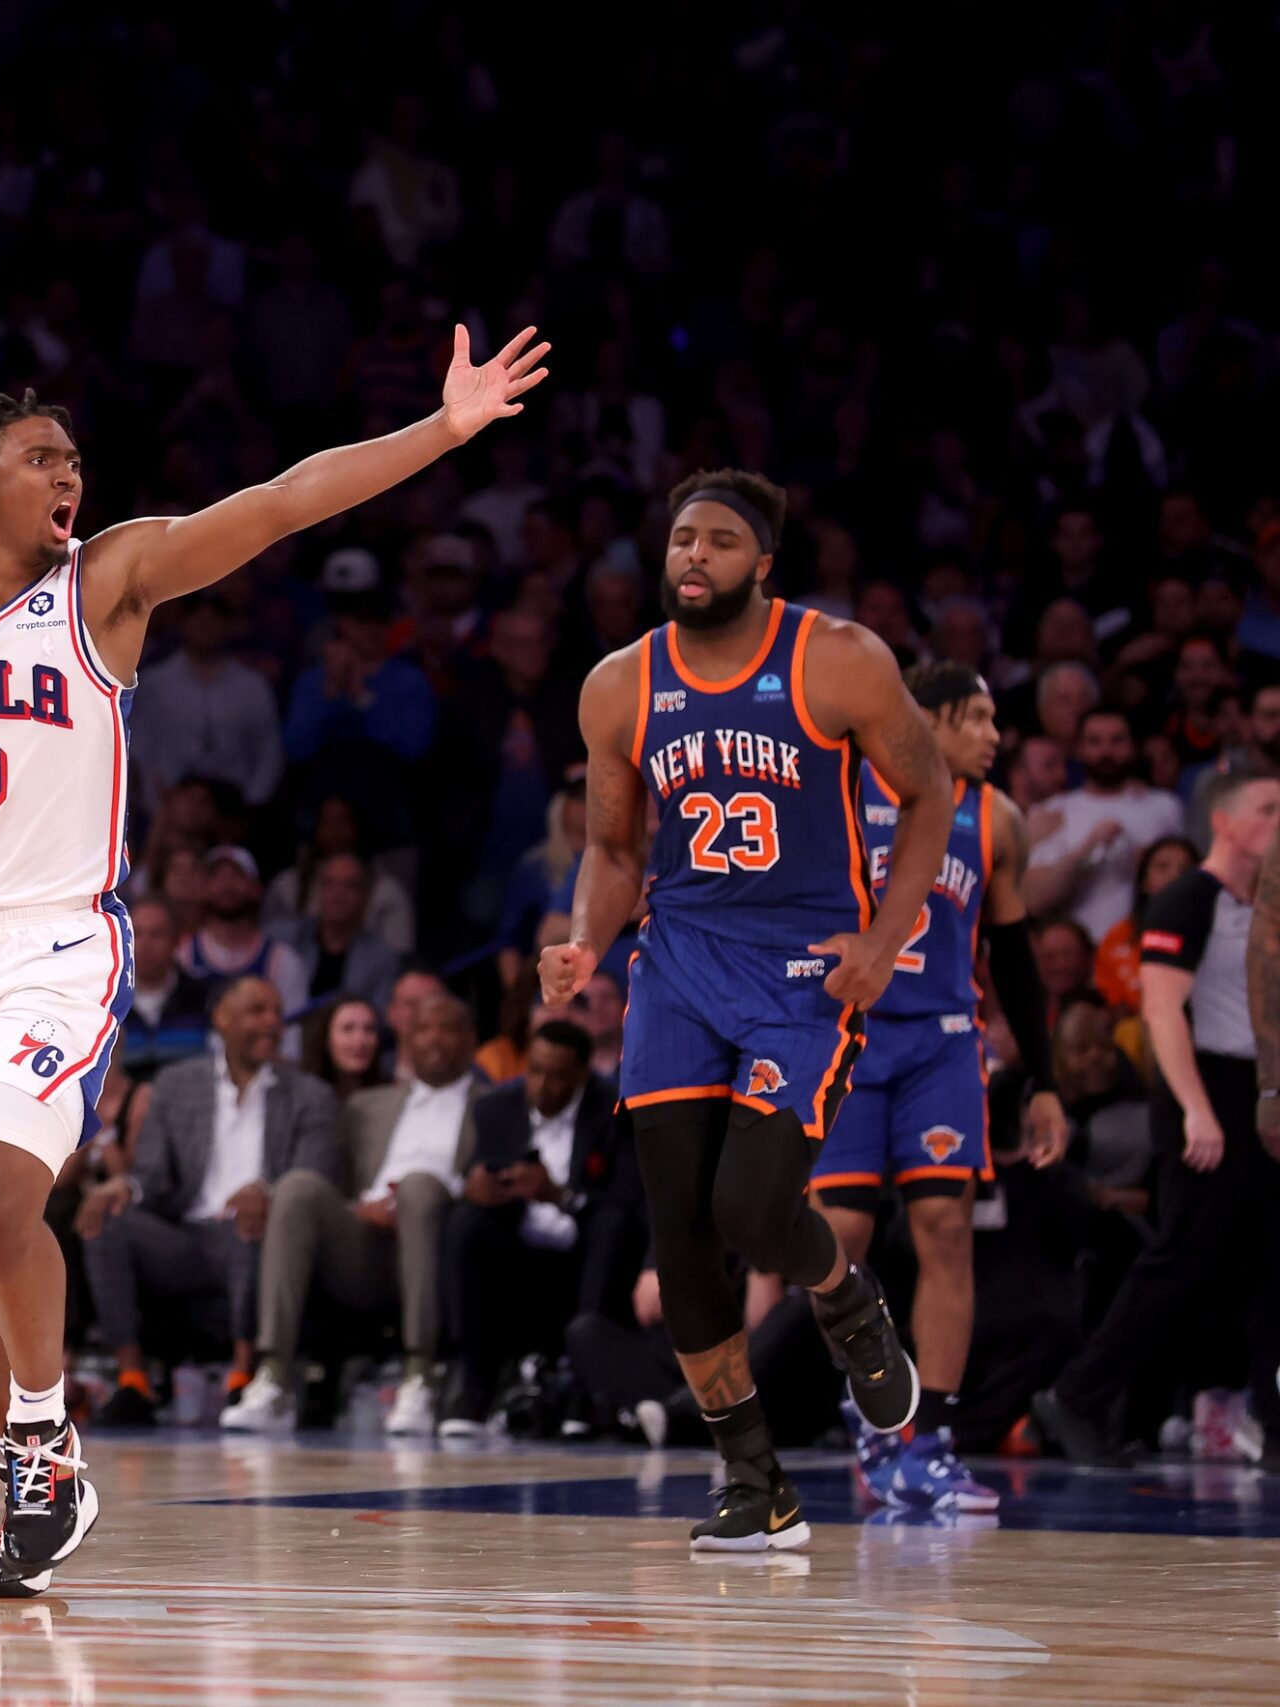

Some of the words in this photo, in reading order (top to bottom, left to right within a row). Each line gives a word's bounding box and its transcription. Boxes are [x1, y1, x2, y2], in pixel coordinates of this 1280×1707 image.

[16, 618, 67, 631] crypto.com
[654, 689, 687, 713] NYC
[649, 731, 705, 798] NEW
[715, 728, 801, 789] YORK
[679, 792, 780, 874] 23
[932, 852, 978, 911] ORK
[786, 958, 825, 978] NYC
[9, 1032, 64, 1078] 76
